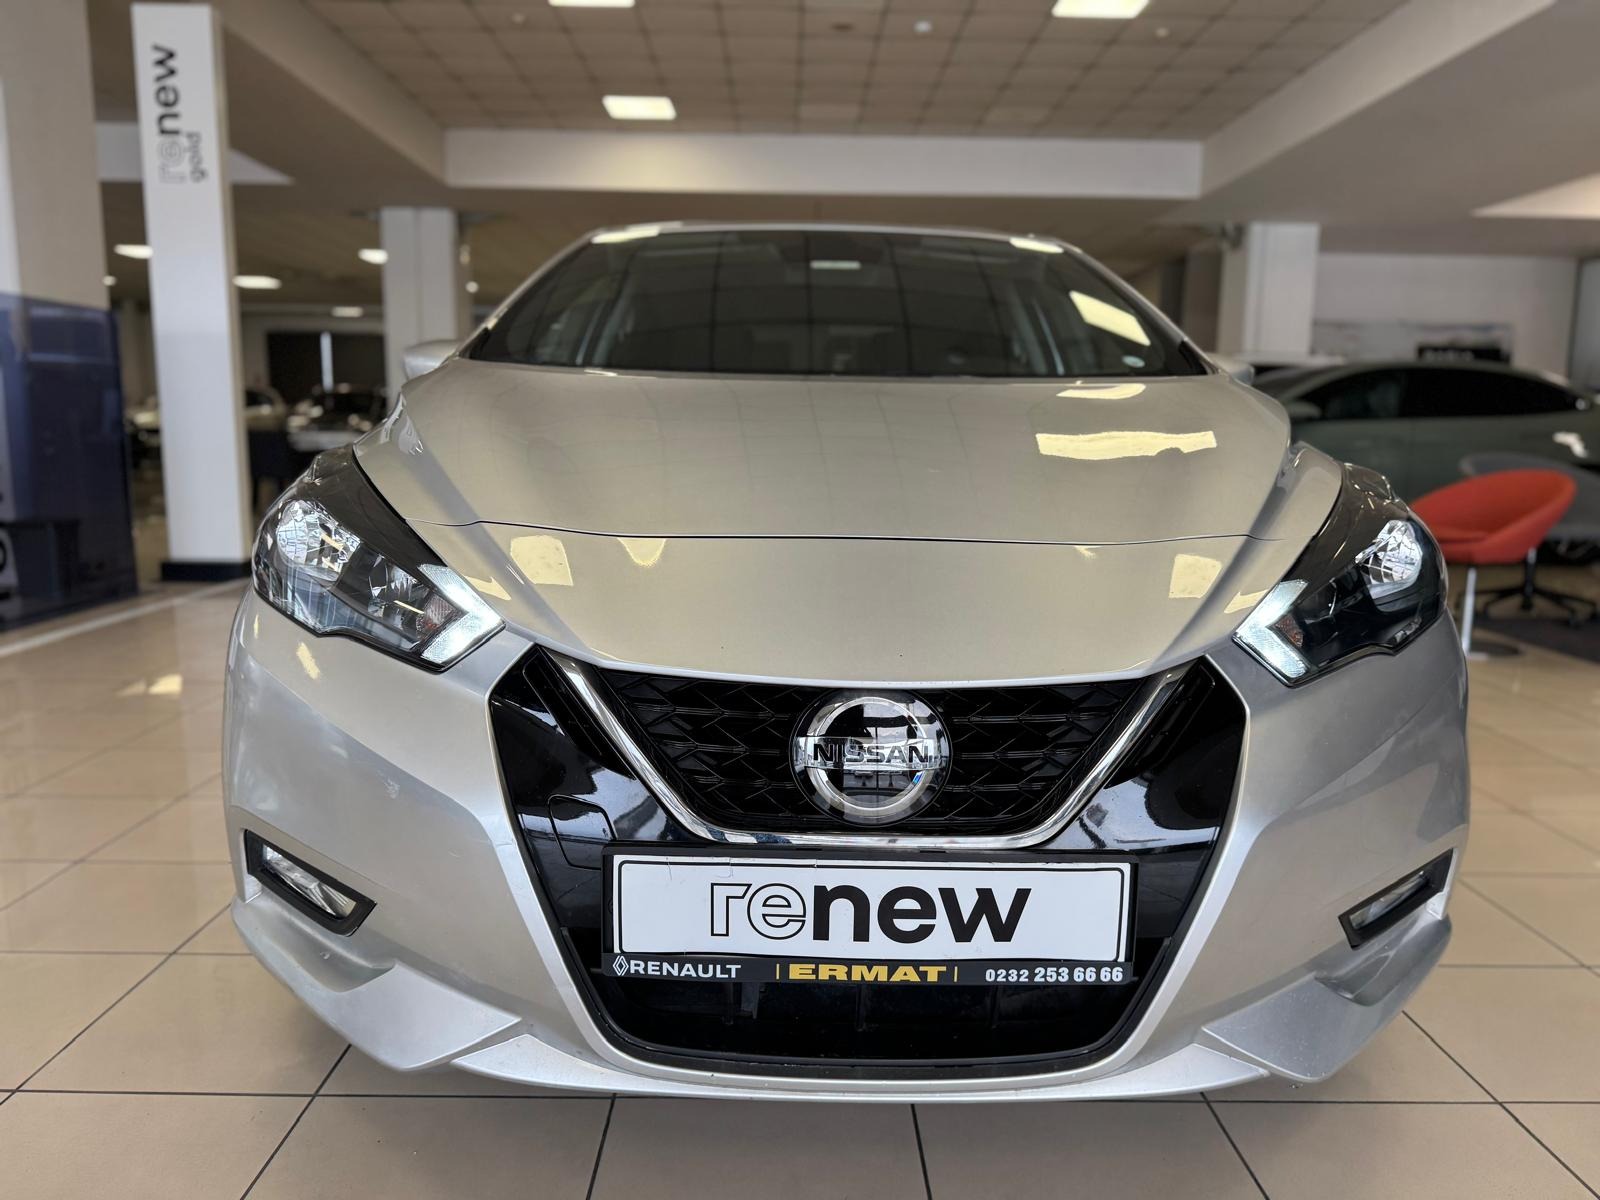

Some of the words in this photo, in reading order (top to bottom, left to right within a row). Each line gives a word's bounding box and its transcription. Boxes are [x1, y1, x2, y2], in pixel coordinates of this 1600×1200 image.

[152, 43, 185, 183] renew
[184, 131, 207, 183] gold
[813, 743, 929, 763] NISSAN
[710, 882, 1032, 944] renew
[629, 959, 742, 979] RENAULT
[788, 963, 947, 983] ERMAT
[985, 968, 1029, 983] 0232
[1034, 966, 1069, 983] 253
[1073, 966, 1096, 983] 66
[1100, 966, 1123, 983] 66
